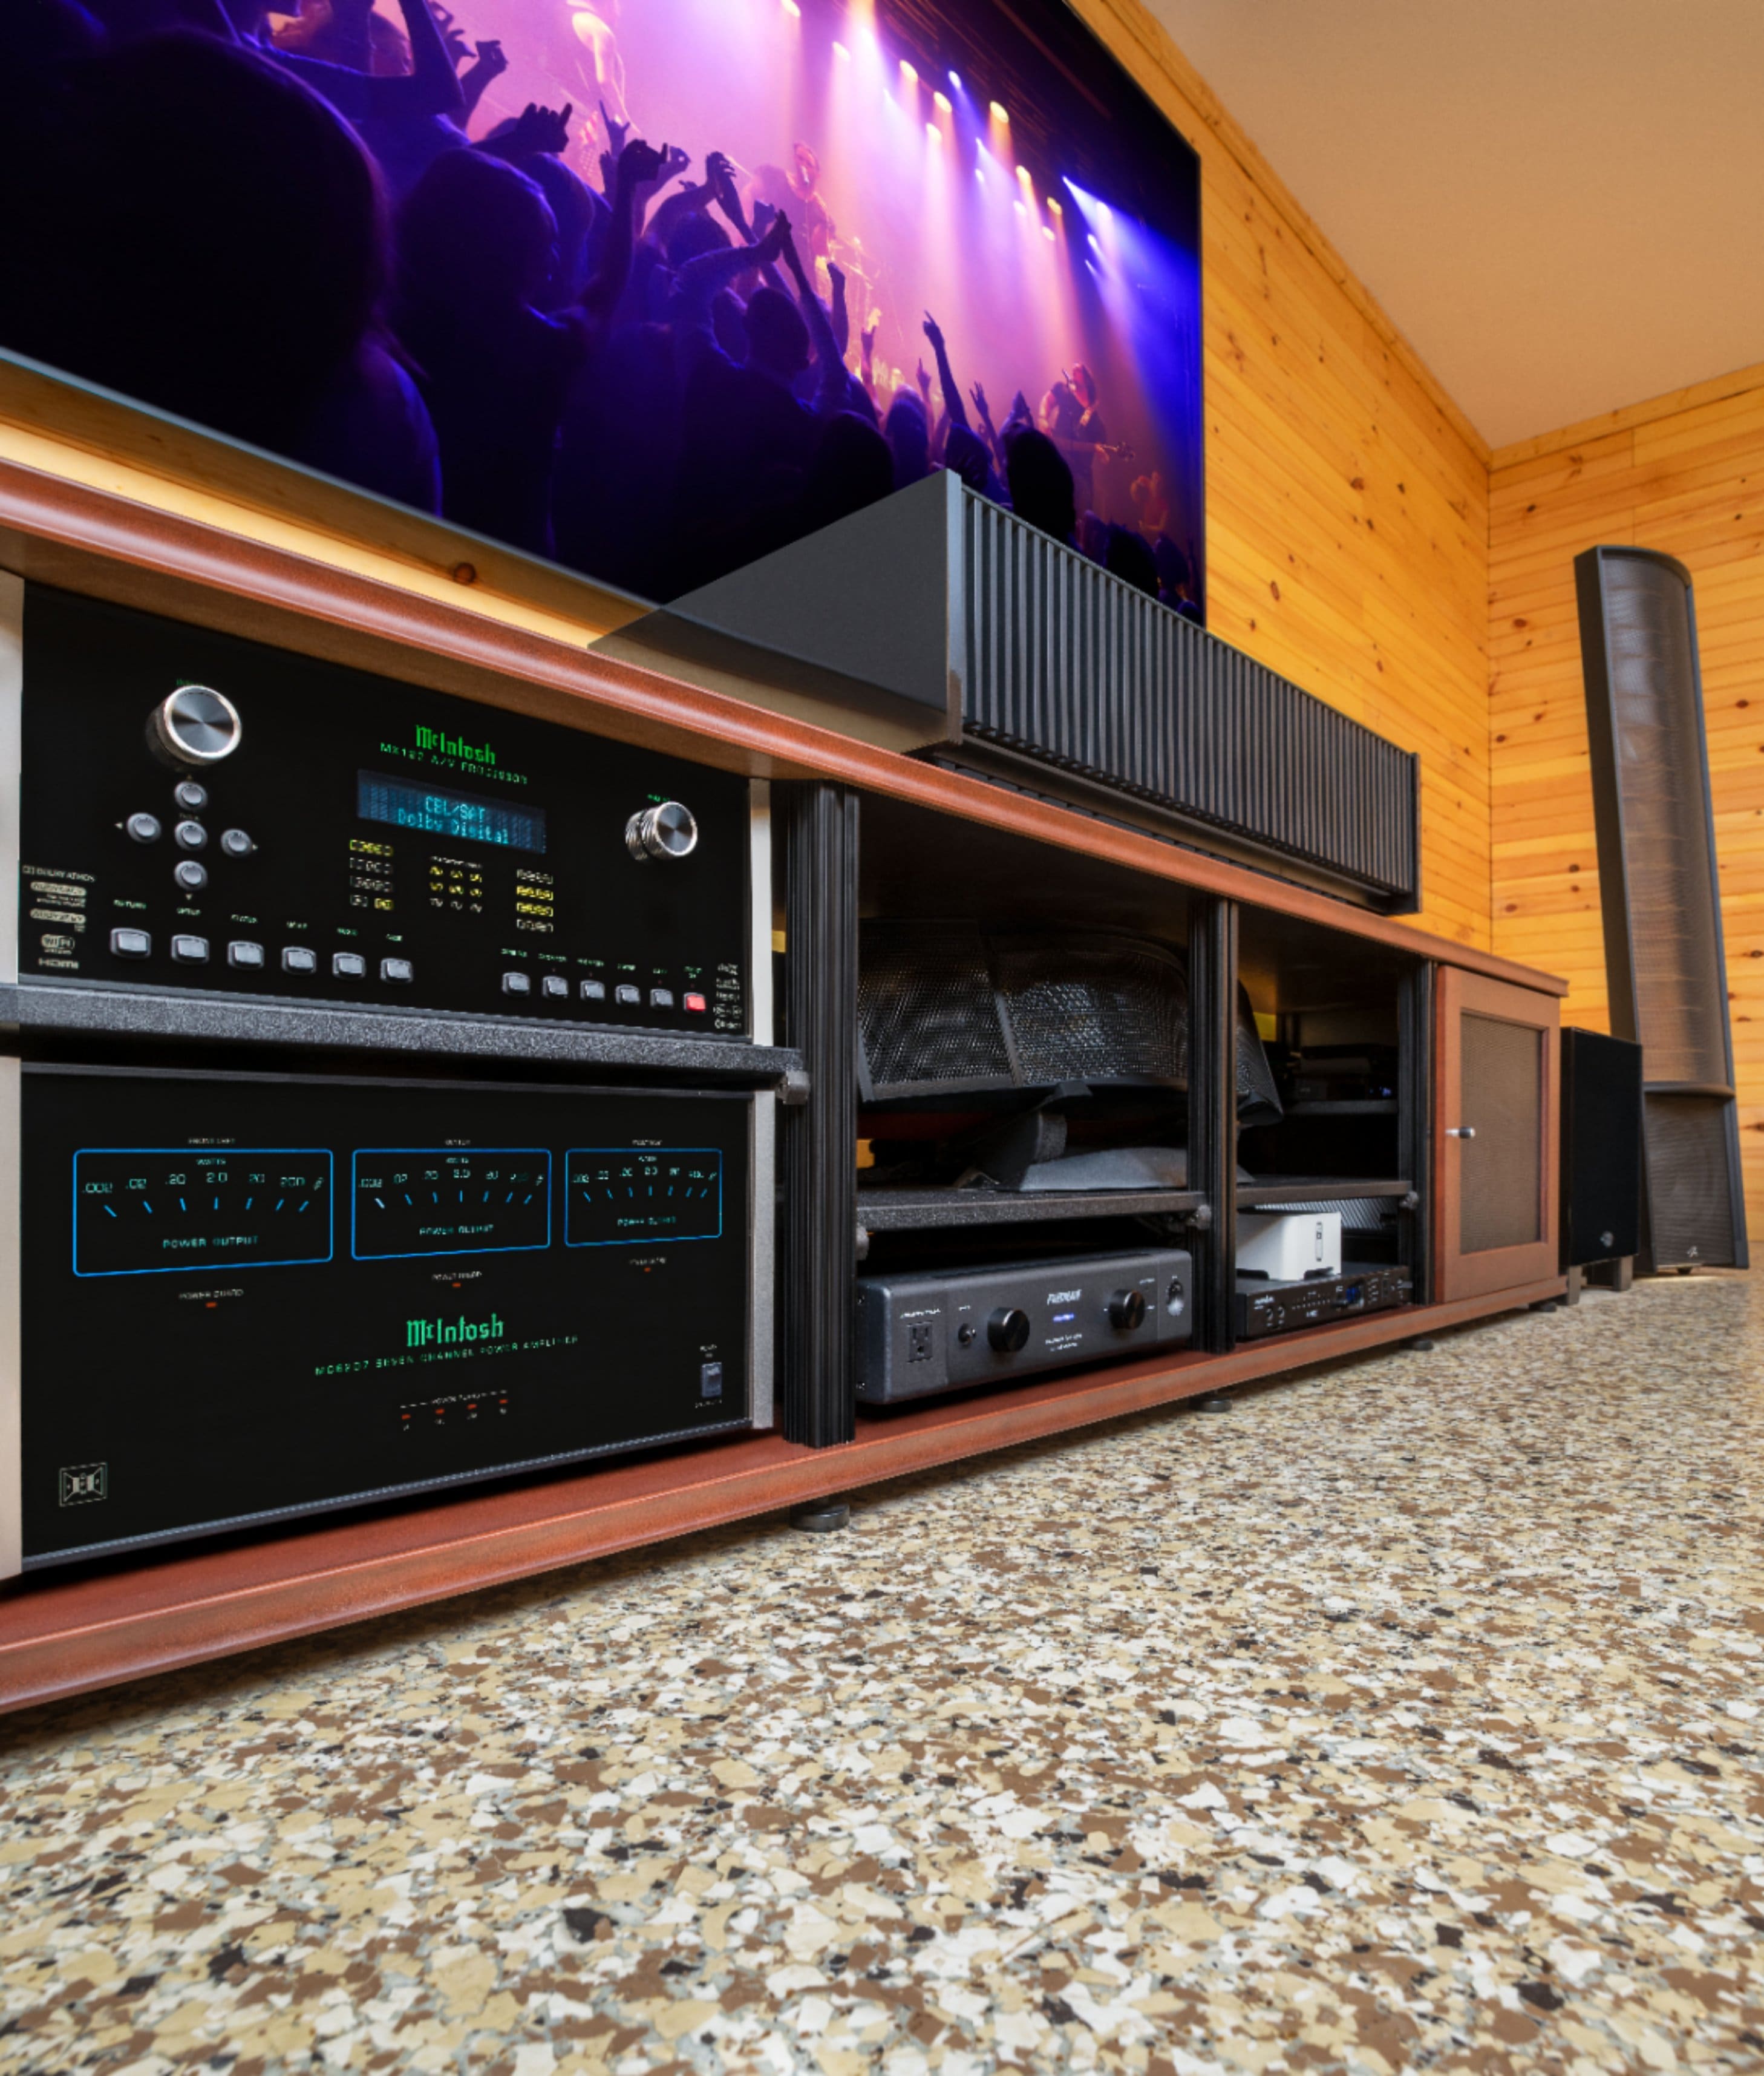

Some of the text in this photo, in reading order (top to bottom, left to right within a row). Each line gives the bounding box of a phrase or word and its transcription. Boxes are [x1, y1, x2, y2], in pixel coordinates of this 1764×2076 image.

[416, 725, 495, 765] McIntosh
[431, 755, 455, 768] A/V
[397, 808, 509, 844] Dolby Digital
[165, 1173, 186, 1185] .20
[163, 1236, 259, 1249] POWER OUTPUT
[407, 1313, 504, 1347] McIntosh
